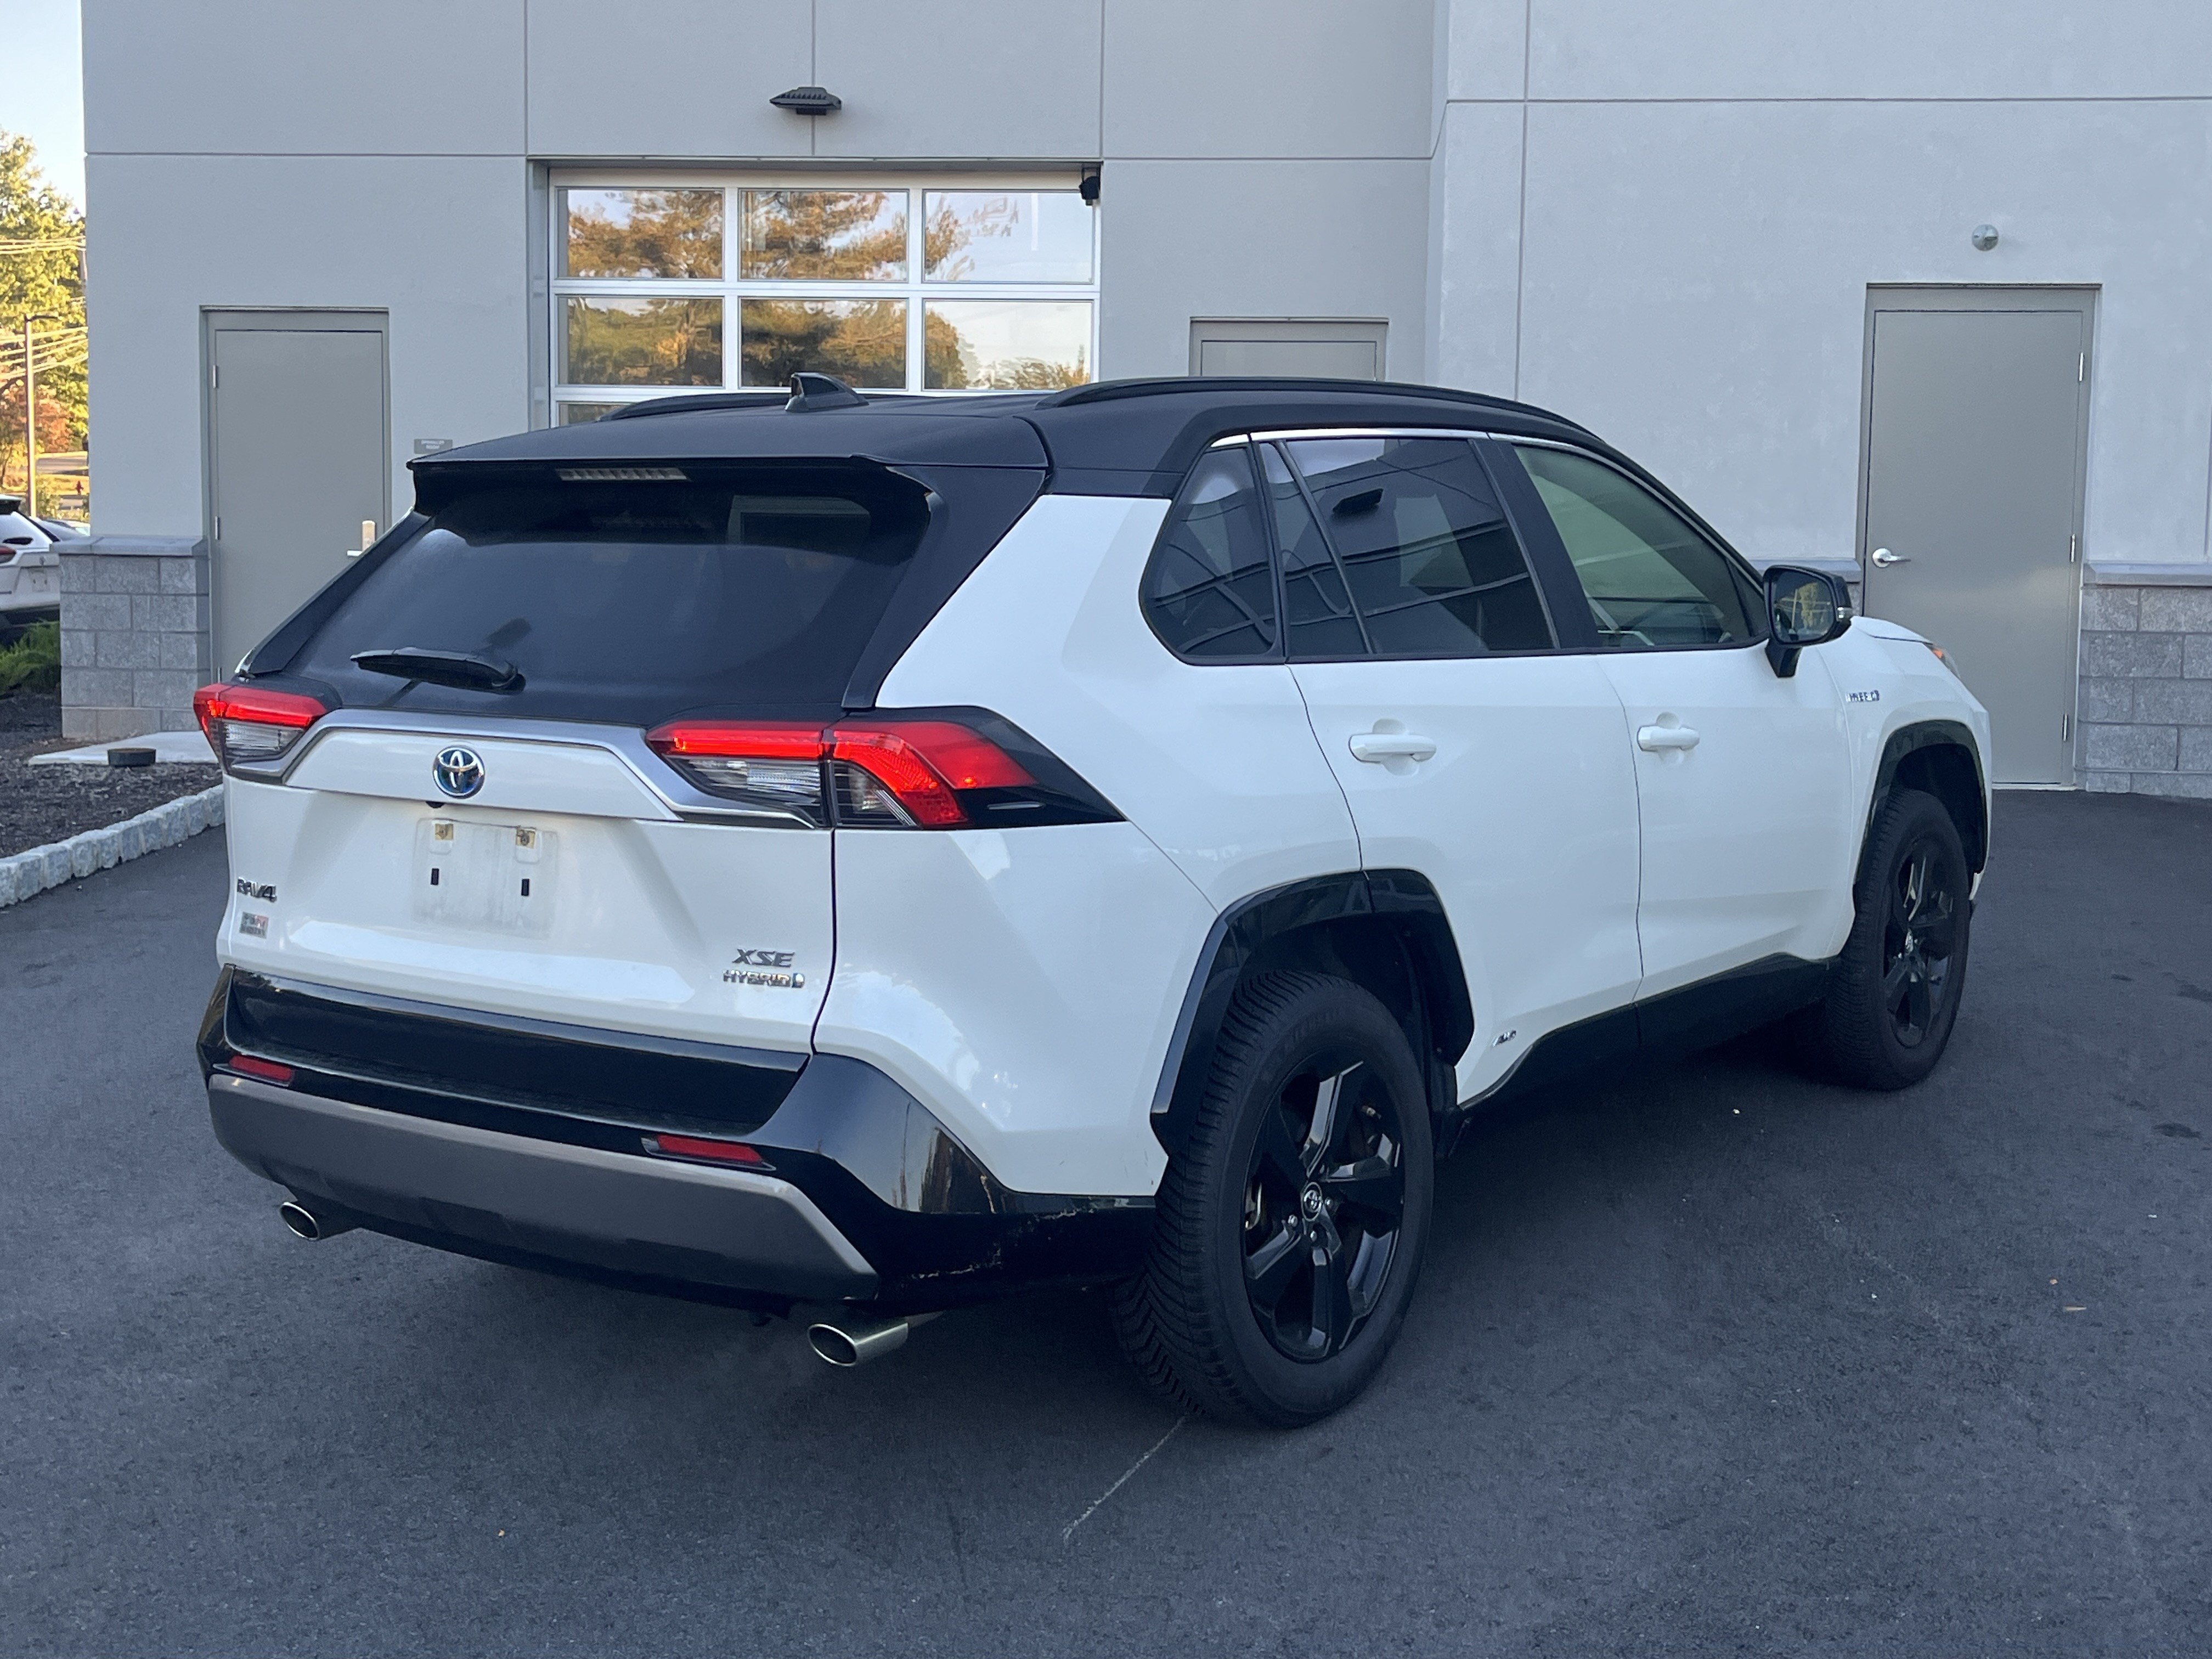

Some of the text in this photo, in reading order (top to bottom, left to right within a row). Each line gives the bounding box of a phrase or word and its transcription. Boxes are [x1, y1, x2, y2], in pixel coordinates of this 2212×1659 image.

[236, 877, 277, 902] RAV4
[732, 947, 795, 968] XSE
[723, 969, 791, 988] HYBRID
